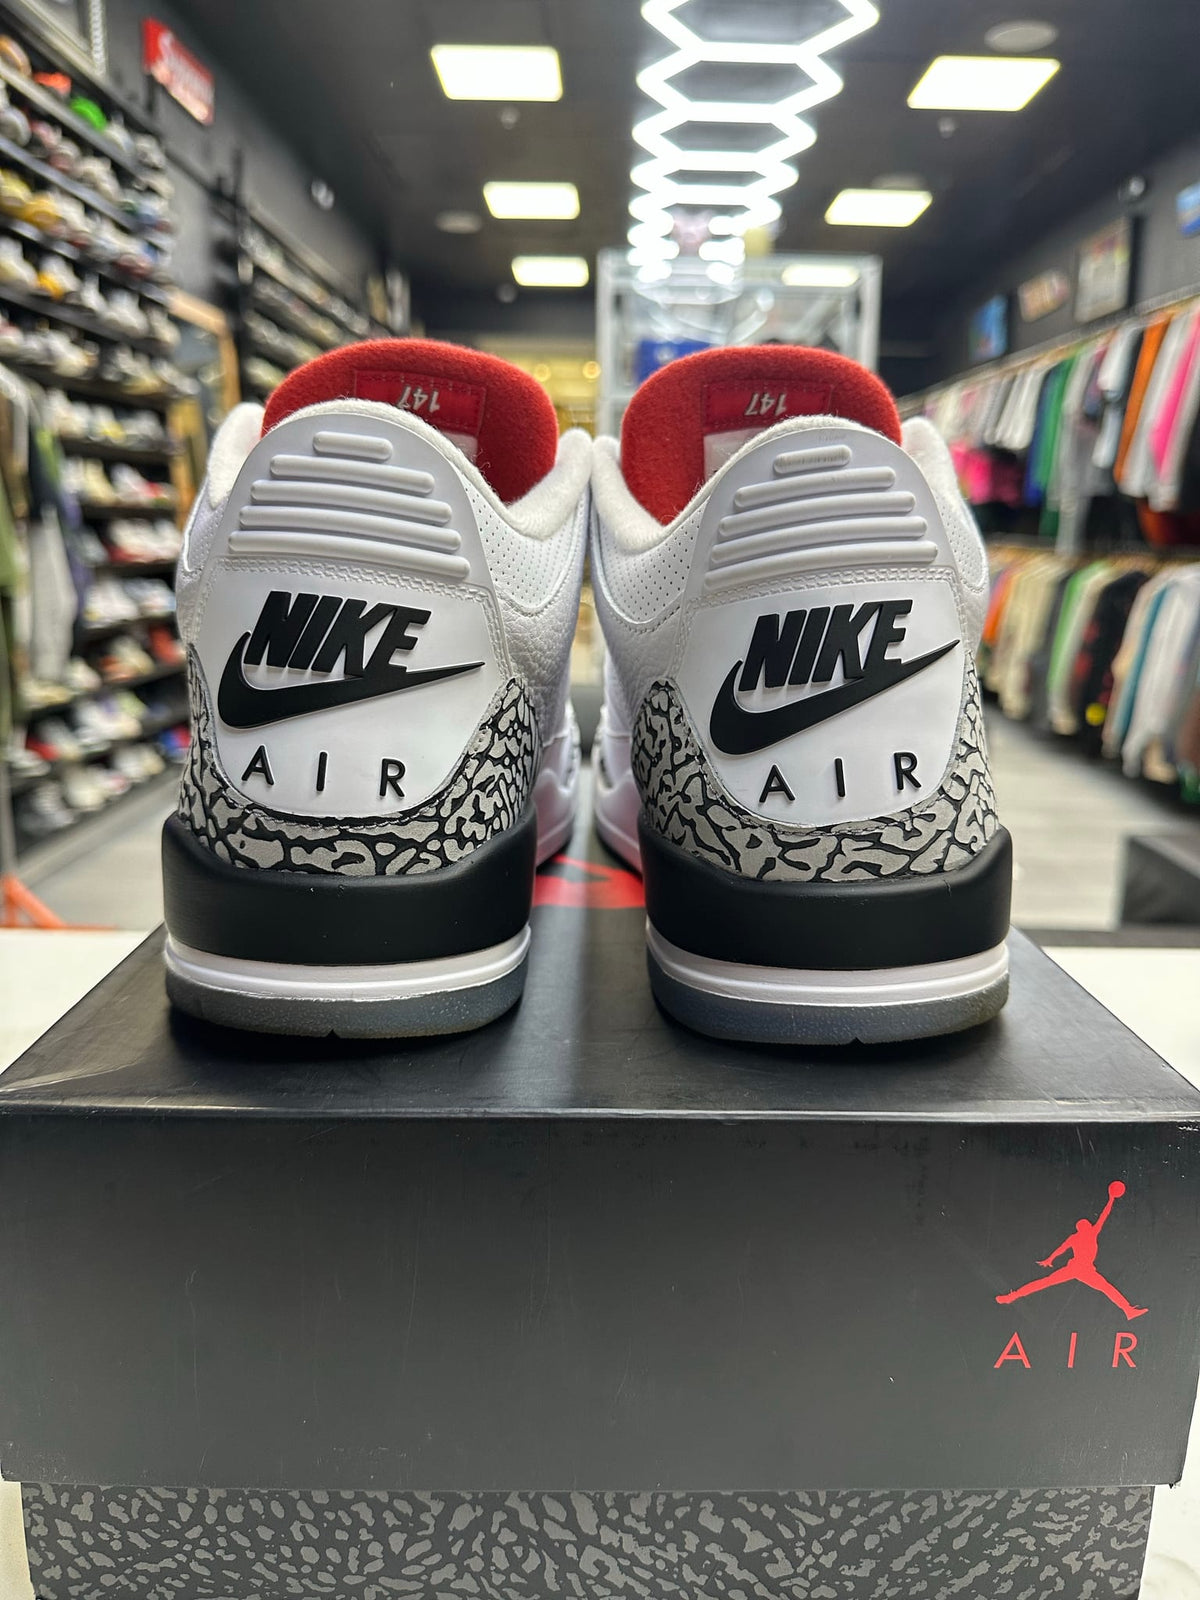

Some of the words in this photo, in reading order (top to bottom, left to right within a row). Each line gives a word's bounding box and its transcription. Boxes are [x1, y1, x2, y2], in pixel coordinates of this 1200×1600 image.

[397, 384, 440, 413] 147
[744, 393, 787, 416] 147
[243, 590, 432, 678] NIKE
[738, 599, 913, 692] NIKE
[241, 745, 406, 798] AIR
[759, 752, 922, 803] AIR
[993, 1331, 1138, 1369] AIR
